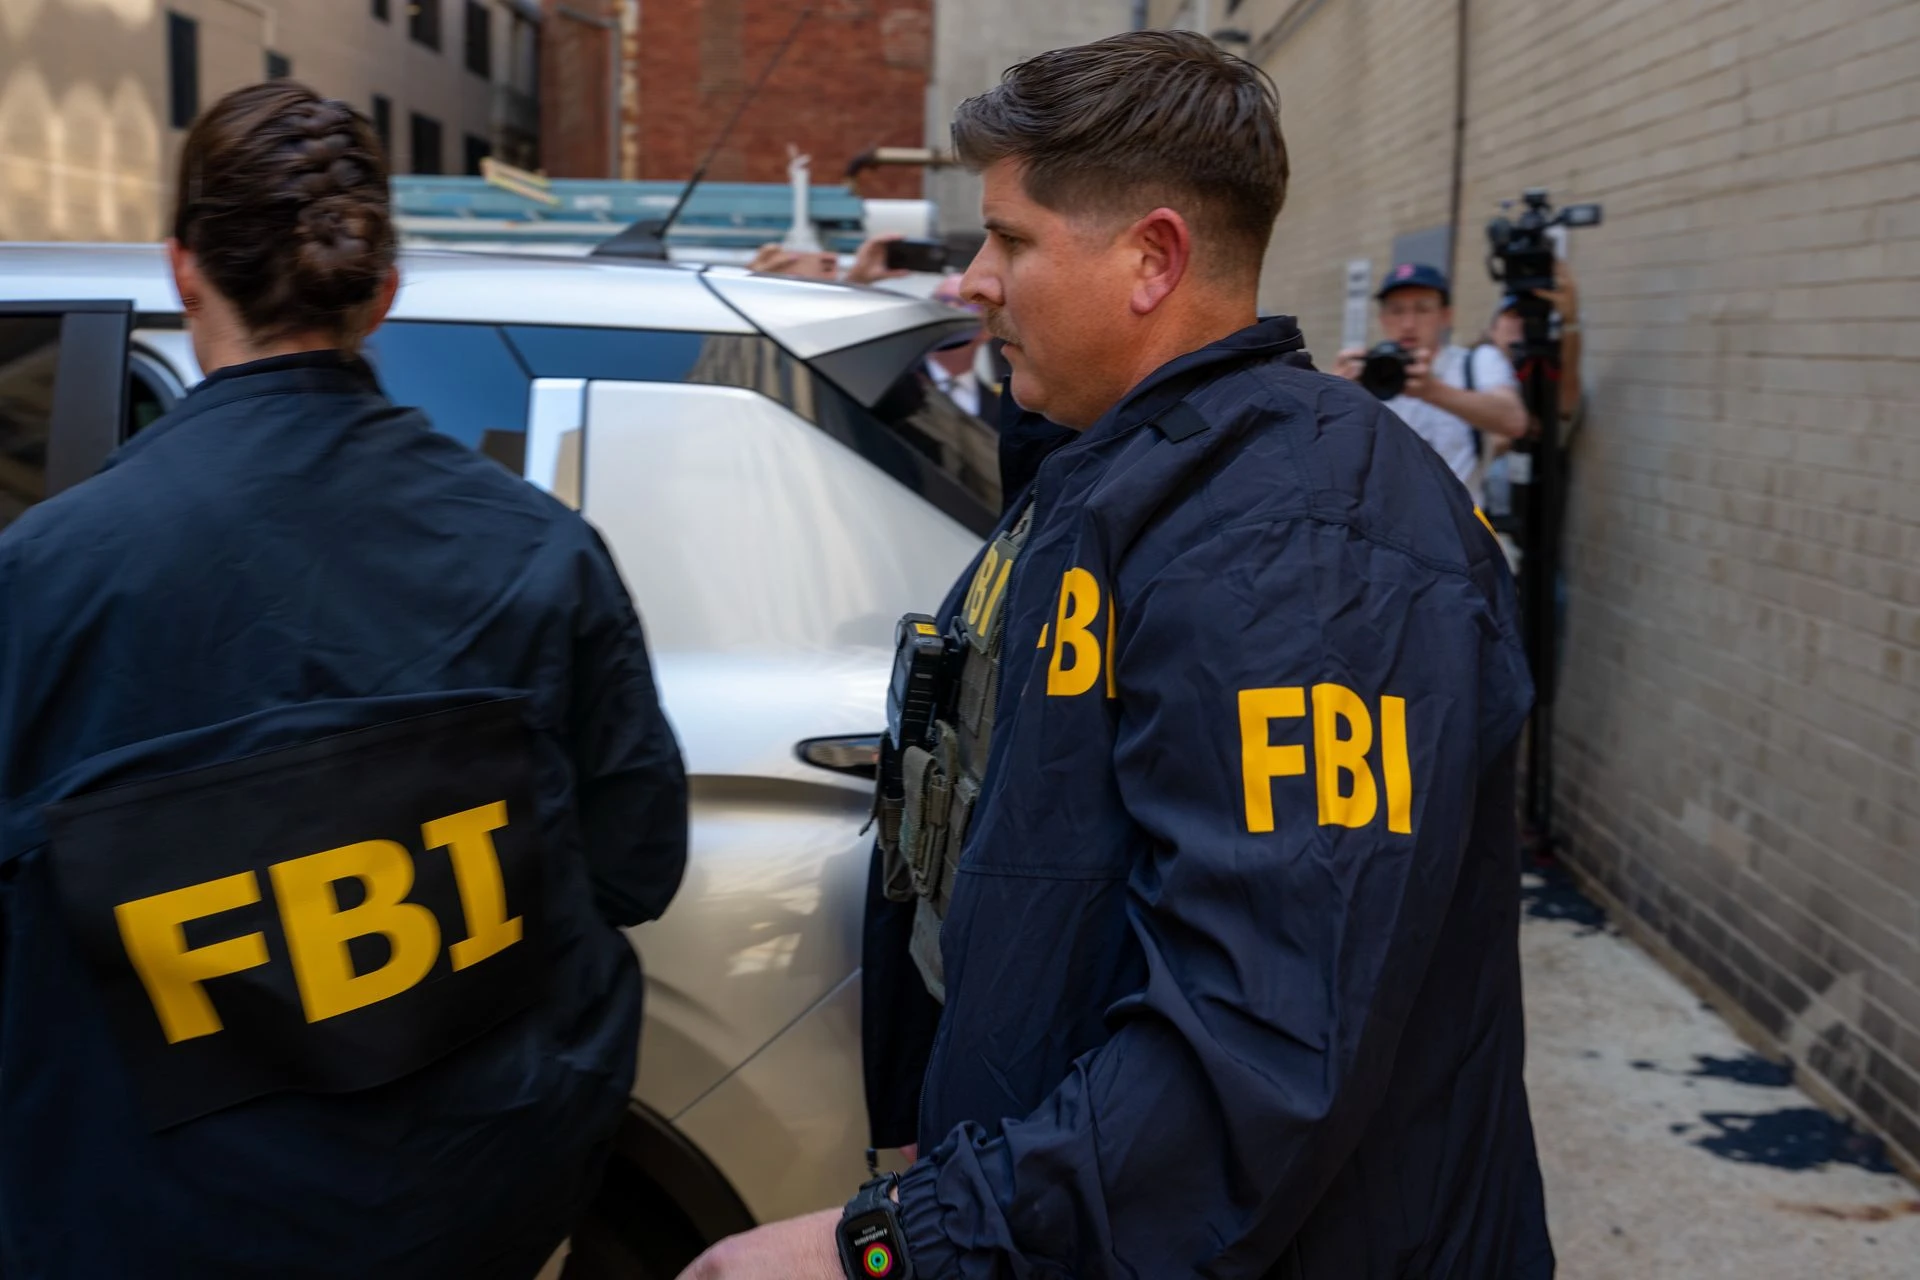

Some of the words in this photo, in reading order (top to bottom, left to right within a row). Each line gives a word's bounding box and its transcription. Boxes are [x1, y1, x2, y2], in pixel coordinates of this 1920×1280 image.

[963, 540, 1014, 637] BI
[1036, 567, 1116, 699] BI
[1237, 682, 1413, 835] FBI
[113, 799, 524, 1045] FBI
